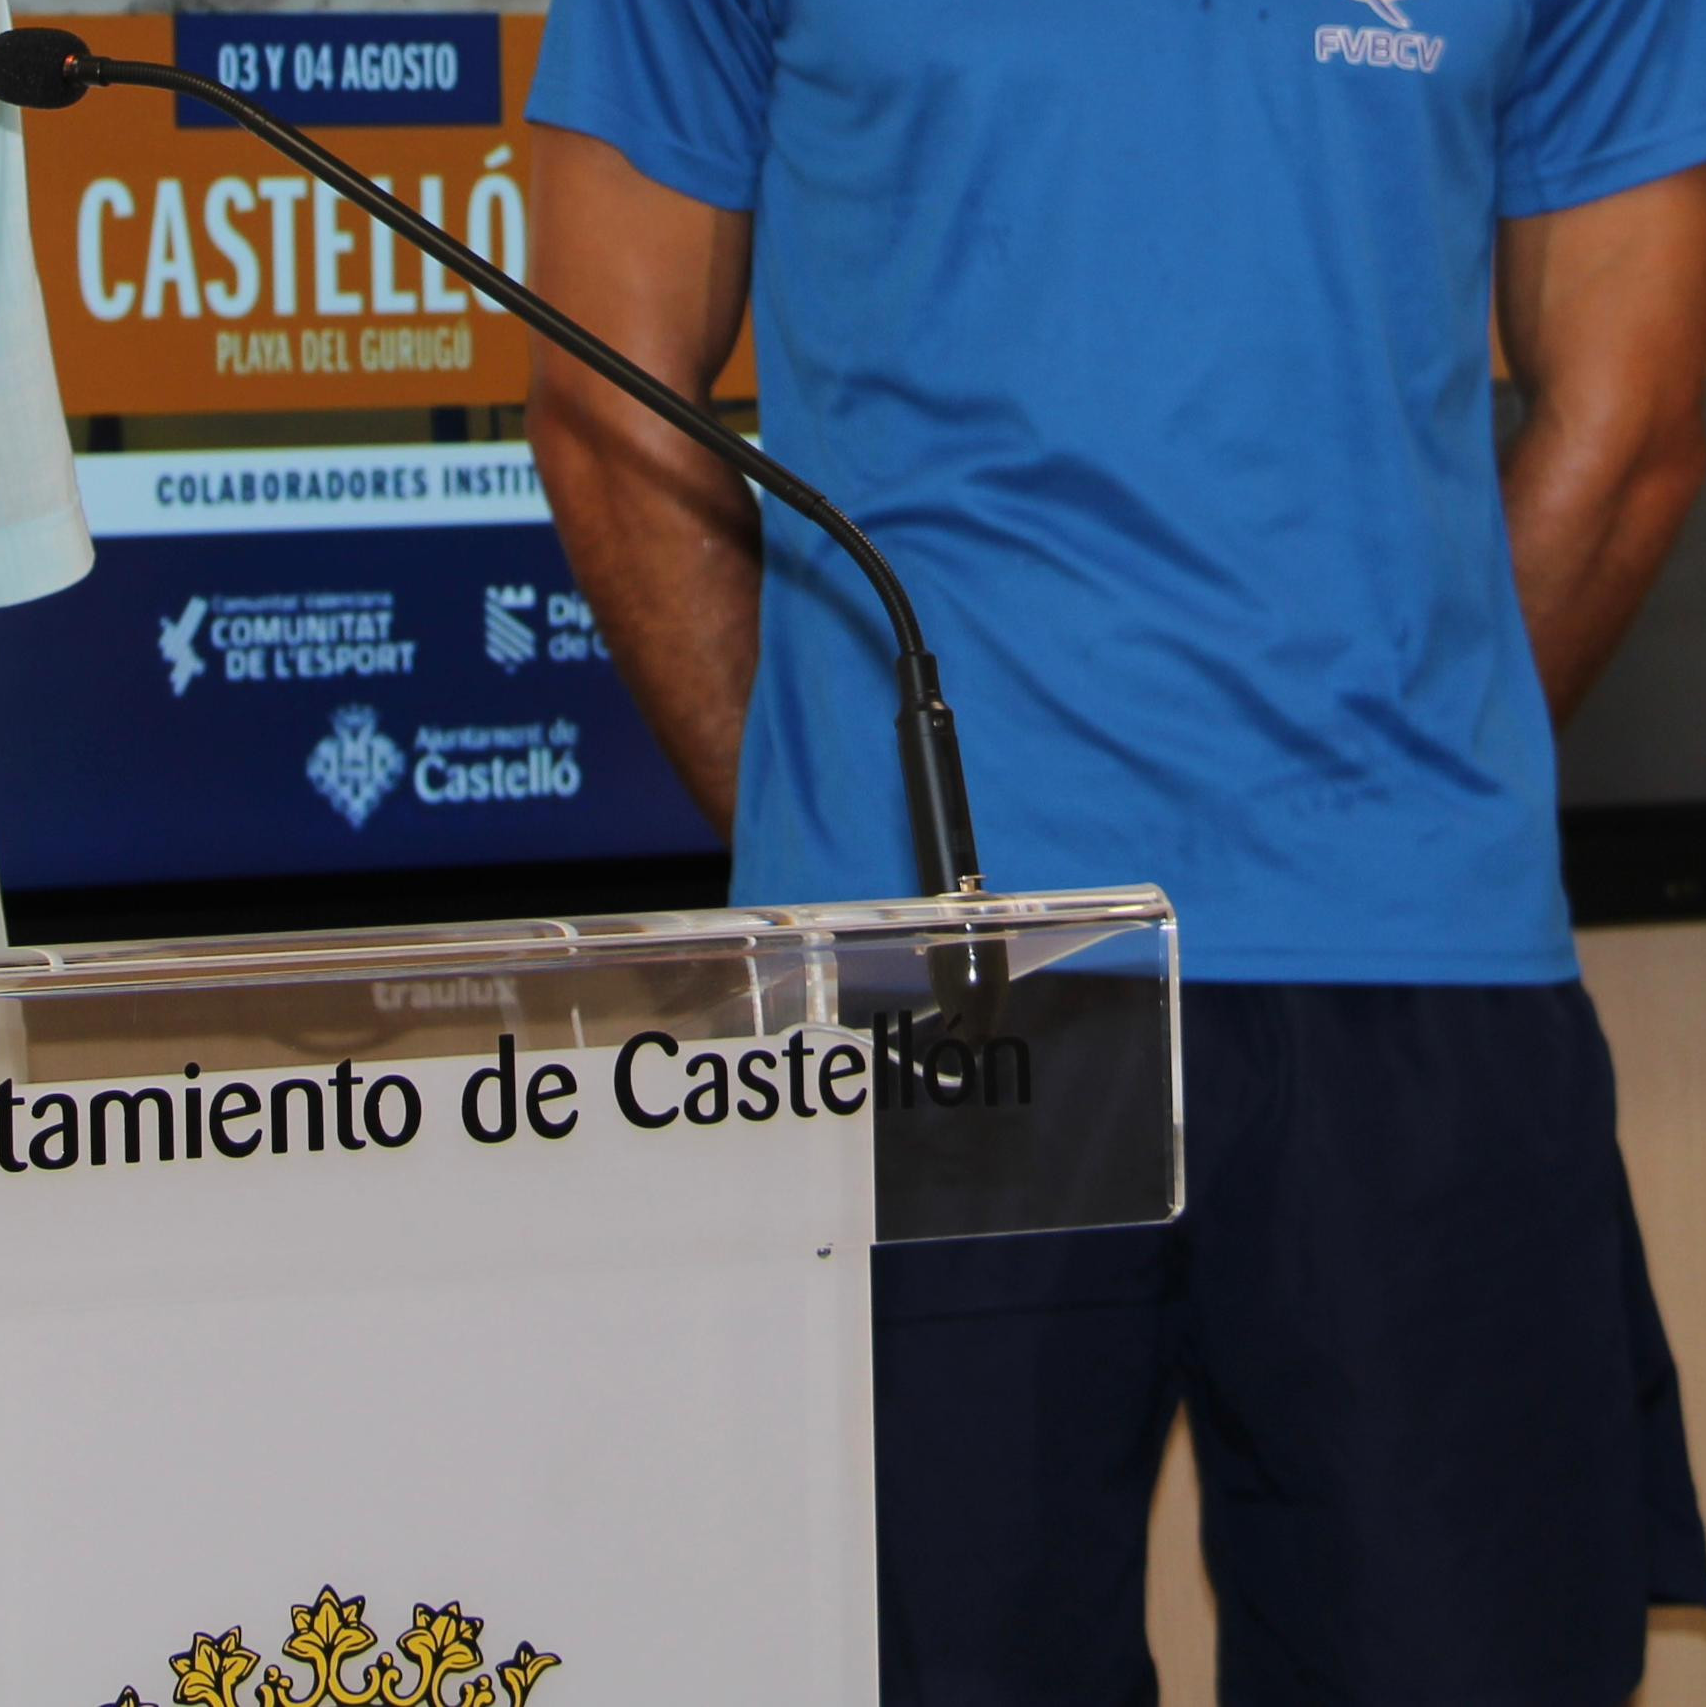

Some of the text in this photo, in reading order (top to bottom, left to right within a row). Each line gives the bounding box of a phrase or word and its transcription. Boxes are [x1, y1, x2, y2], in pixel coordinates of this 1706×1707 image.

[217, 41, 459, 92] 03 Y 04 AGOSTO
[1315, 24, 1445, 75] FVBCV
[76, 144, 529, 322] CASTELLÓ
[216, 331, 293, 375] PLAYA
[301, 329, 352, 373] DEL
[157, 463, 539, 507] COLABORADORES INSTIT
[211, 610, 392, 650] COMUNITAT
[548, 635, 588, 661] de
[226, 647, 267, 681] DE
[413, 746, 581, 805] Castelló
[462, 1034, 579, 1143] de
[614, 1010, 1032, 1128] Castellón
